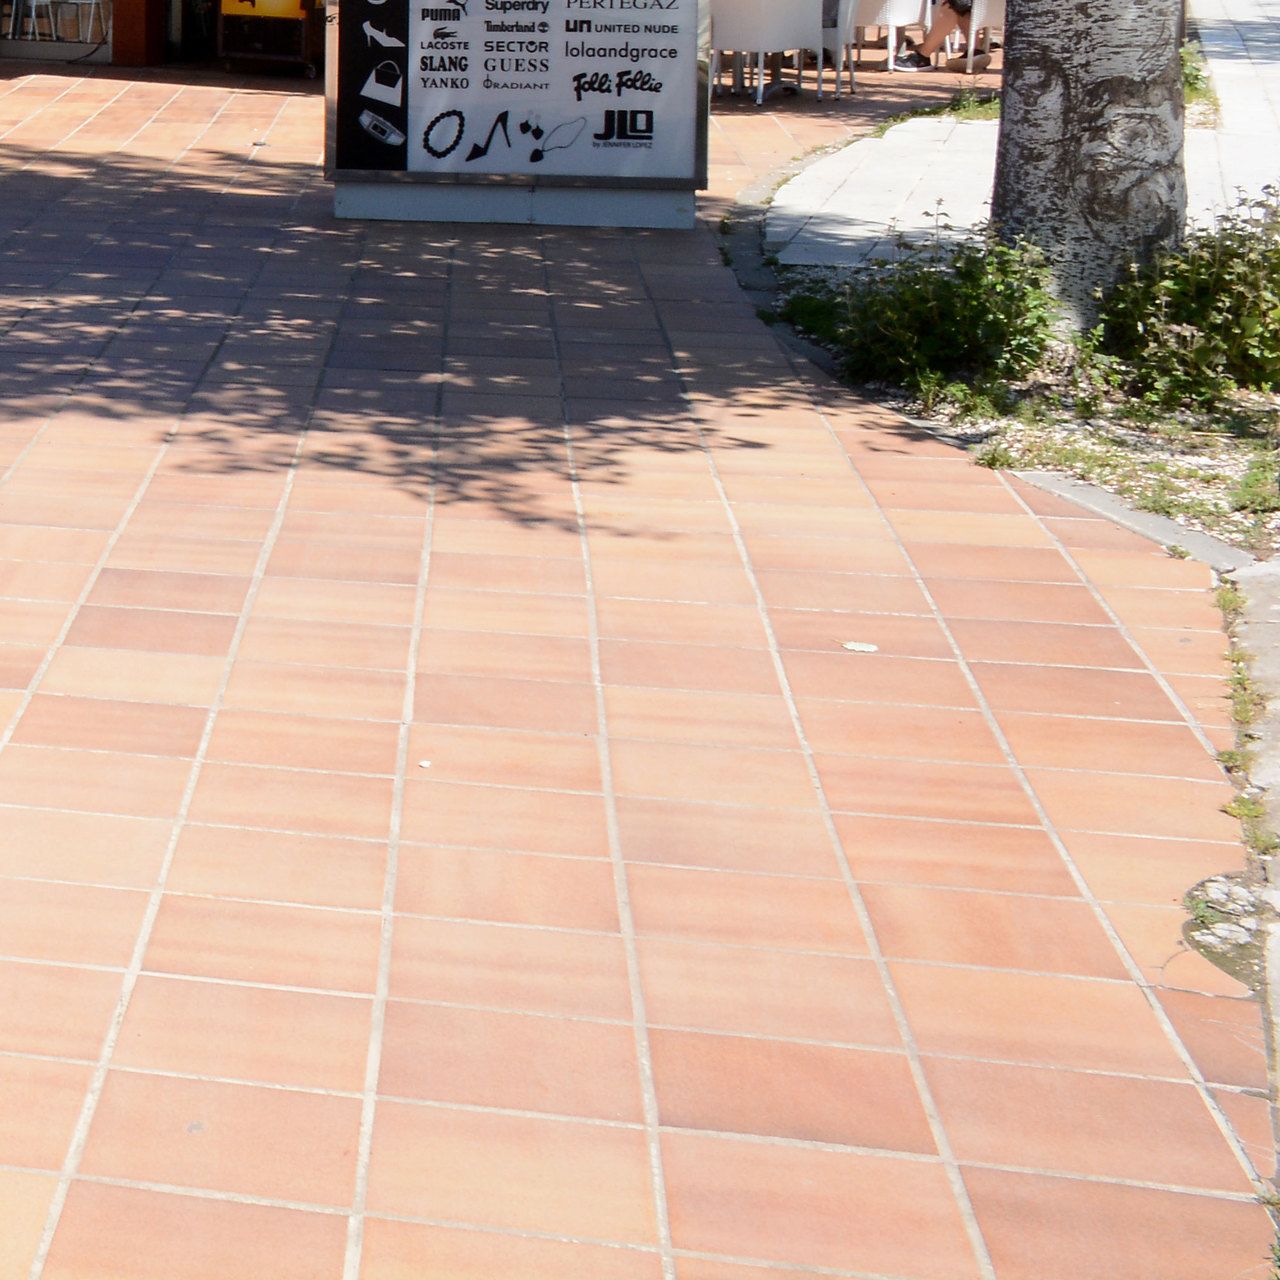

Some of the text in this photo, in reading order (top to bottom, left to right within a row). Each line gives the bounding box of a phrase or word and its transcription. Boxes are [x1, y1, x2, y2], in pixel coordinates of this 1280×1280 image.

[421, 8, 460, 21] PUMA
[484, 20, 536, 33] Timberland
[595, 24, 640, 34] UNITED
[644, 24, 679, 34] NUDE
[420, 41, 469, 50] LACOSTE
[484, 40, 549, 53] SECTOR
[565, 41, 678, 62] lolaandgrace
[420, 55, 468, 72] SLANG
[483, 58, 549, 72] GUESS
[420, 78, 469, 89] YANKO
[493, 81, 550, 90] RADIANT
[572, 70, 663, 101] Folli Follie
[593, 109, 654, 141] JLO
